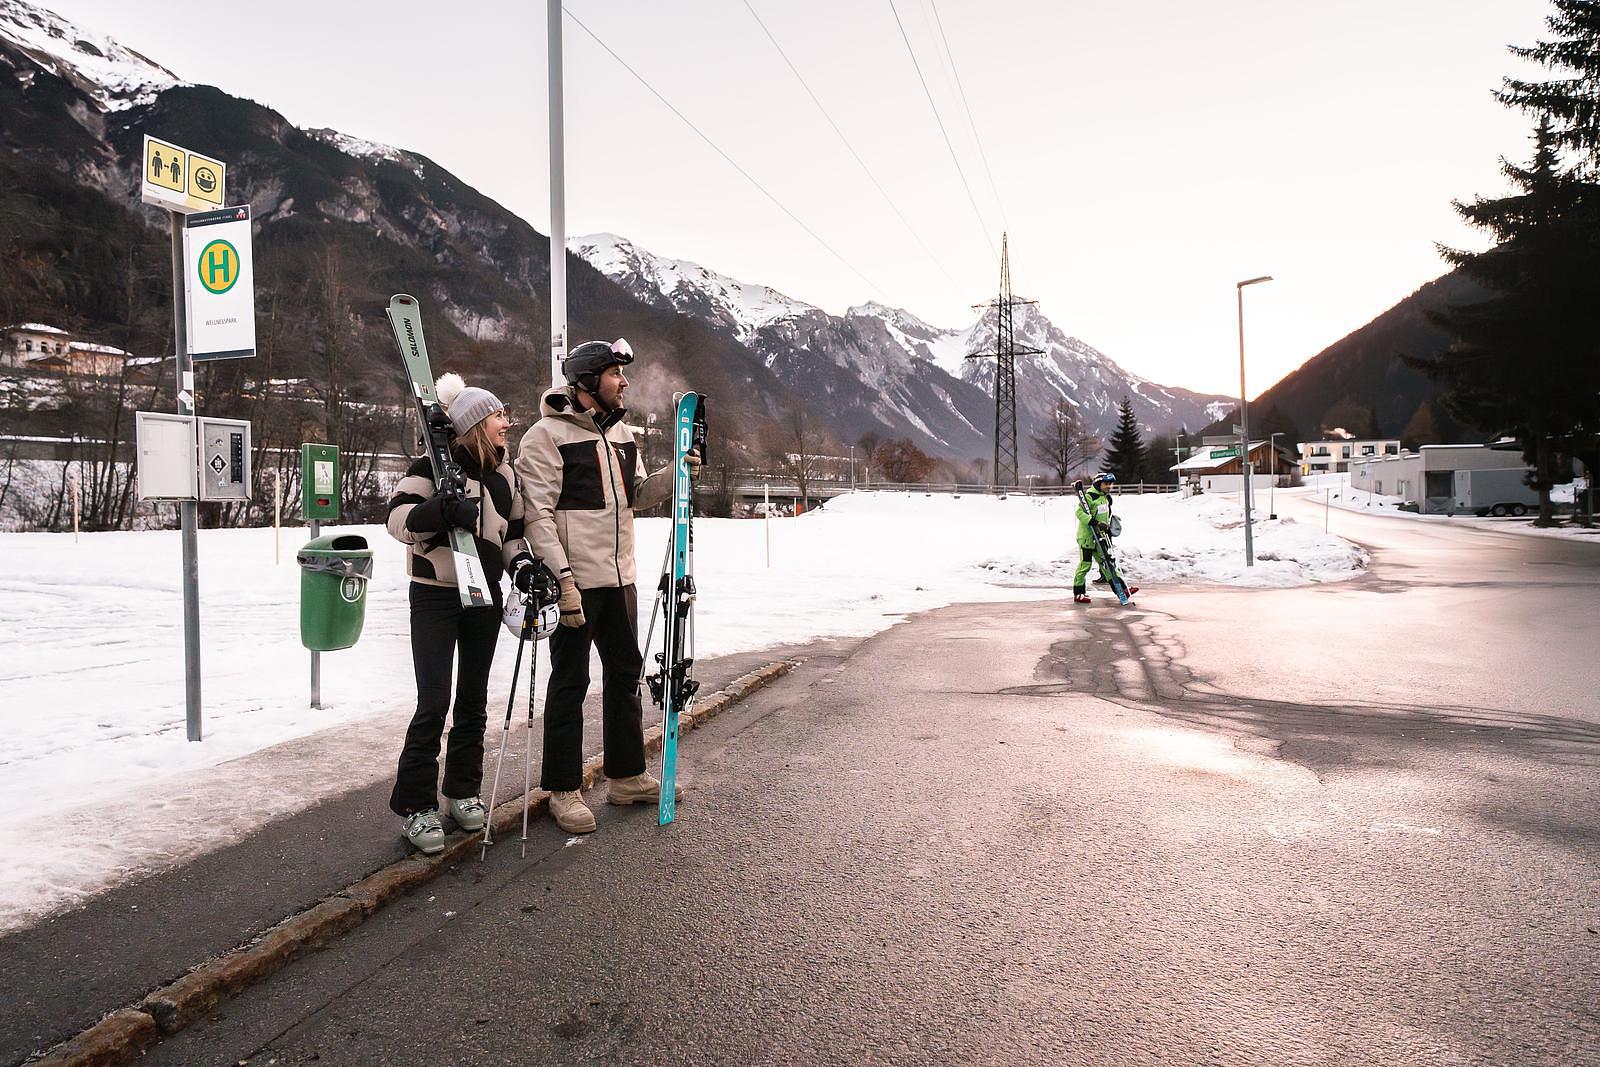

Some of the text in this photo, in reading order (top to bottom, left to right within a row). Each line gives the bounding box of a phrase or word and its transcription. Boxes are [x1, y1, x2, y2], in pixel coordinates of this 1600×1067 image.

[208, 250, 230, 284] H
[403, 317, 420, 358] SALOMON
[678, 427, 690, 525] HEAD
